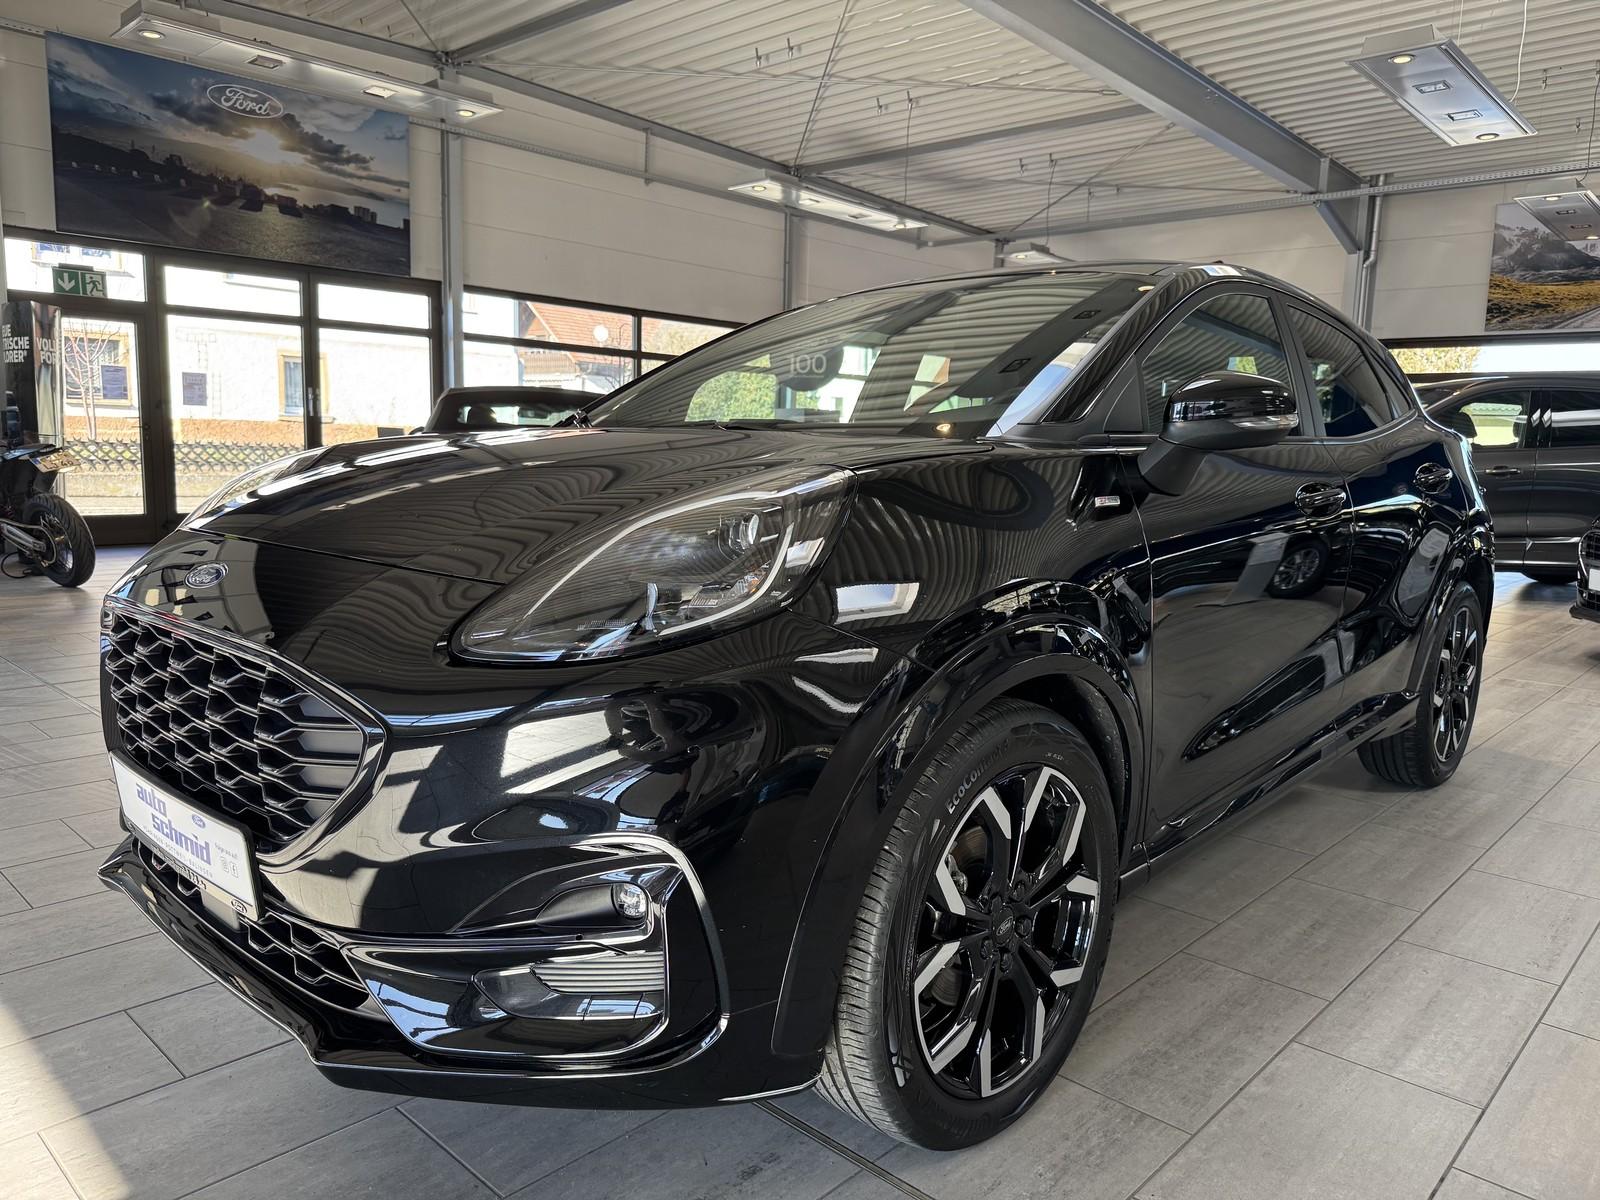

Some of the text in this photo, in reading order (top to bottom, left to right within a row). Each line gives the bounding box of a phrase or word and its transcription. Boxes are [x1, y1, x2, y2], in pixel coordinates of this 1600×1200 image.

[221, 87, 271, 115] Ford
[135, 782, 168, 818] auto
[151, 812, 212, 866] schmid
